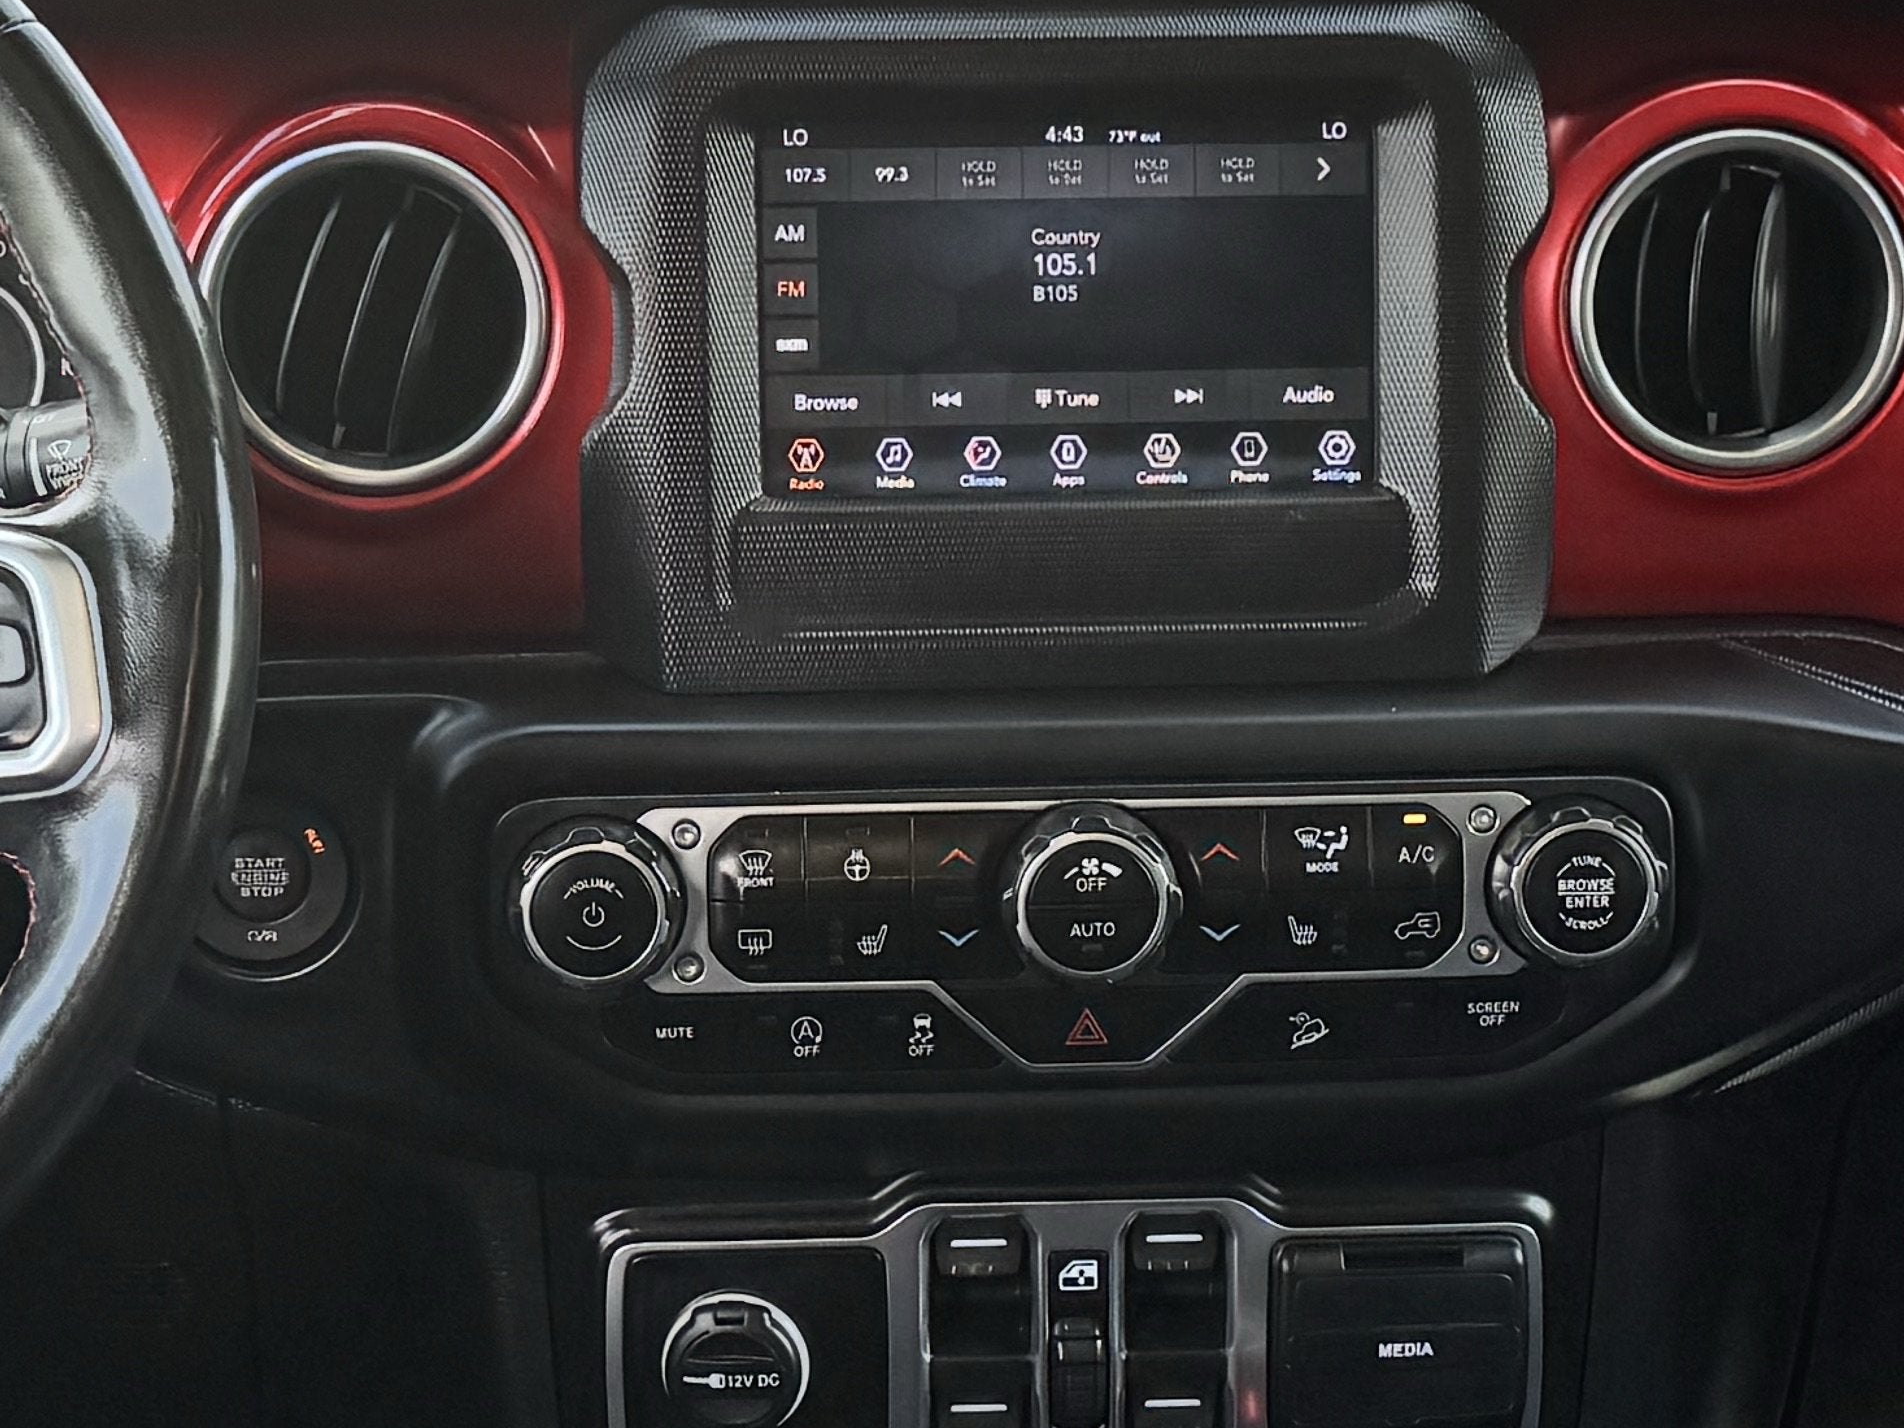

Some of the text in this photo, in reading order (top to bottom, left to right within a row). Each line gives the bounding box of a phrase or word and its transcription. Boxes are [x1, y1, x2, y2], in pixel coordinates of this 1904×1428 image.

[782, 128, 809, 147] LO
[1044, 126, 1084, 144] 4:43
[1321, 122, 1347, 141] LO
[784, 168, 827, 184] 107.5
[874, 166, 910, 183] 99.3
[774, 224, 805, 243] AM
[1031, 228, 1102, 249] Country
[1033, 252, 1097, 276] 105.1
[777, 280, 806, 298] FM
[1032, 284, 1080, 303] B105
[793, 393, 860, 412] Browse
[1055, 389, 1101, 408] Tune
[1283, 386, 1336, 404] Audio
[789, 477, 825, 491] Radio
[876, 475, 916, 490] Media
[959, 473, 1008, 489] Climate
[1052, 471, 1086, 490] Apps
[1135, 470, 1189, 486] Controls
[1230, 469, 1271, 485] Phone
[1311, 467, 1363, 485] Settings
[1398, 845, 1435, 864] A/C
[1572, 855, 1603, 869] TUNE
[234, 857, 286, 869] START
[1305, 861, 1339, 874] MODE
[736, 876, 774, 888] FRONT
[1075, 877, 1108, 893] OFF
[1557, 878, 1615, 892] BROWSE
[240, 885, 285, 898] STOP
[1565, 895, 1610, 910] ENTER
[1069, 922, 1116, 938] AUTO
[1563, 916, 1609, 931] SCROLL
[1467, 1001, 1520, 1015] SCREEN
[1479, 1014, 1507, 1027] OFF
[655, 1026, 694, 1039] MUTE
[793, 1044, 821, 1058] OFF
[908, 1043, 935, 1057] OFF
[1378, 1341, 1435, 1359] MEDIA
[727, 1373, 780, 1388] 12V DC
